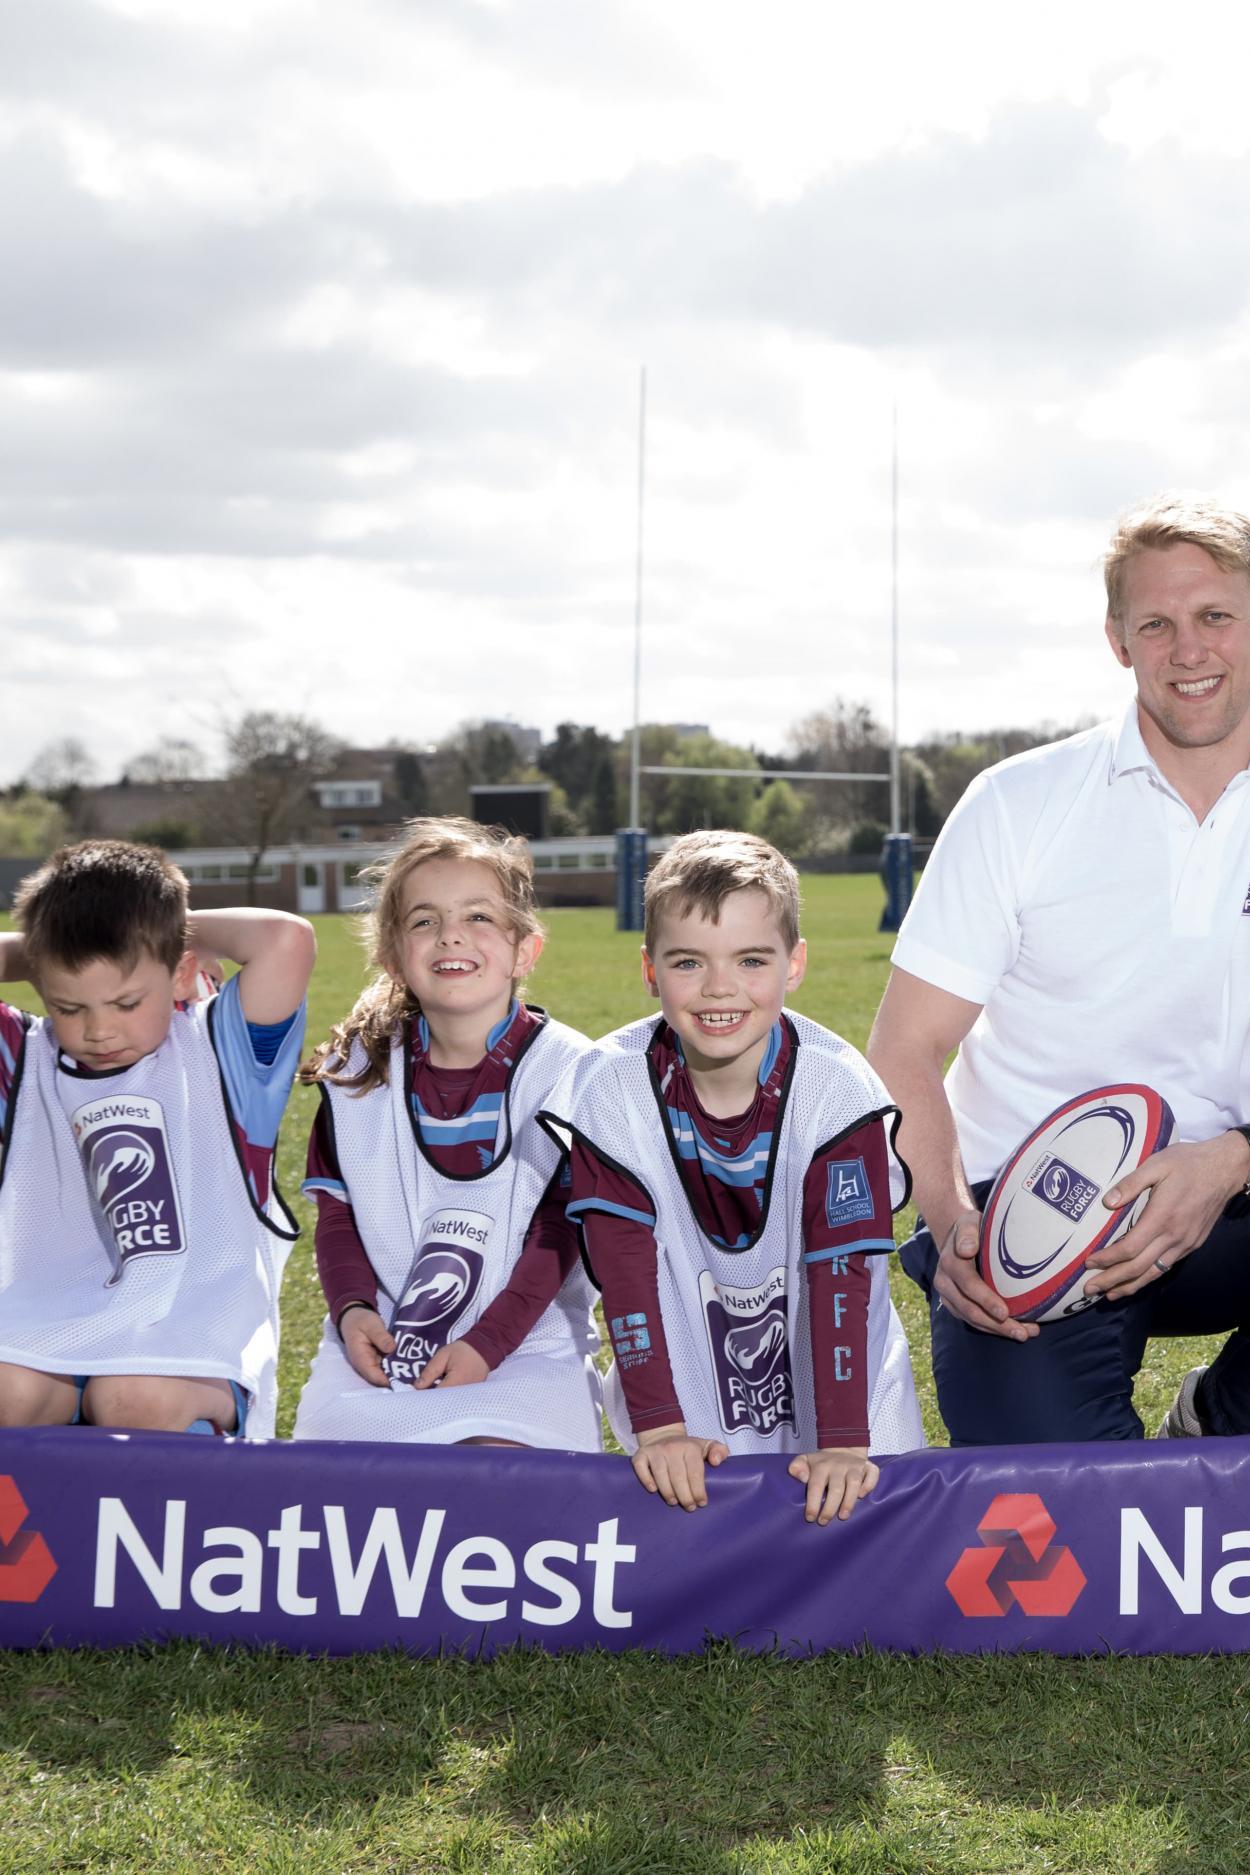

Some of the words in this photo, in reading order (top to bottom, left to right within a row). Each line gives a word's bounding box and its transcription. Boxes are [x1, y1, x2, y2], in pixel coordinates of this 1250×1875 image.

[82, 1105, 150, 1128] NatWest
[1030, 1155, 1051, 1181] NatWest
[1060, 1179, 1087, 1212] RUGBY
[1070, 1185, 1096, 1219] FORCE
[109, 1200, 166, 1229] GBY
[831, 1208, 872, 1223] WIMBLEDON
[116, 1224, 171, 1254] RCE
[725, 1276, 784, 1309] NatWest
[732, 1395, 792, 1429] FORC
[94, 1497, 636, 1629] NatWest
